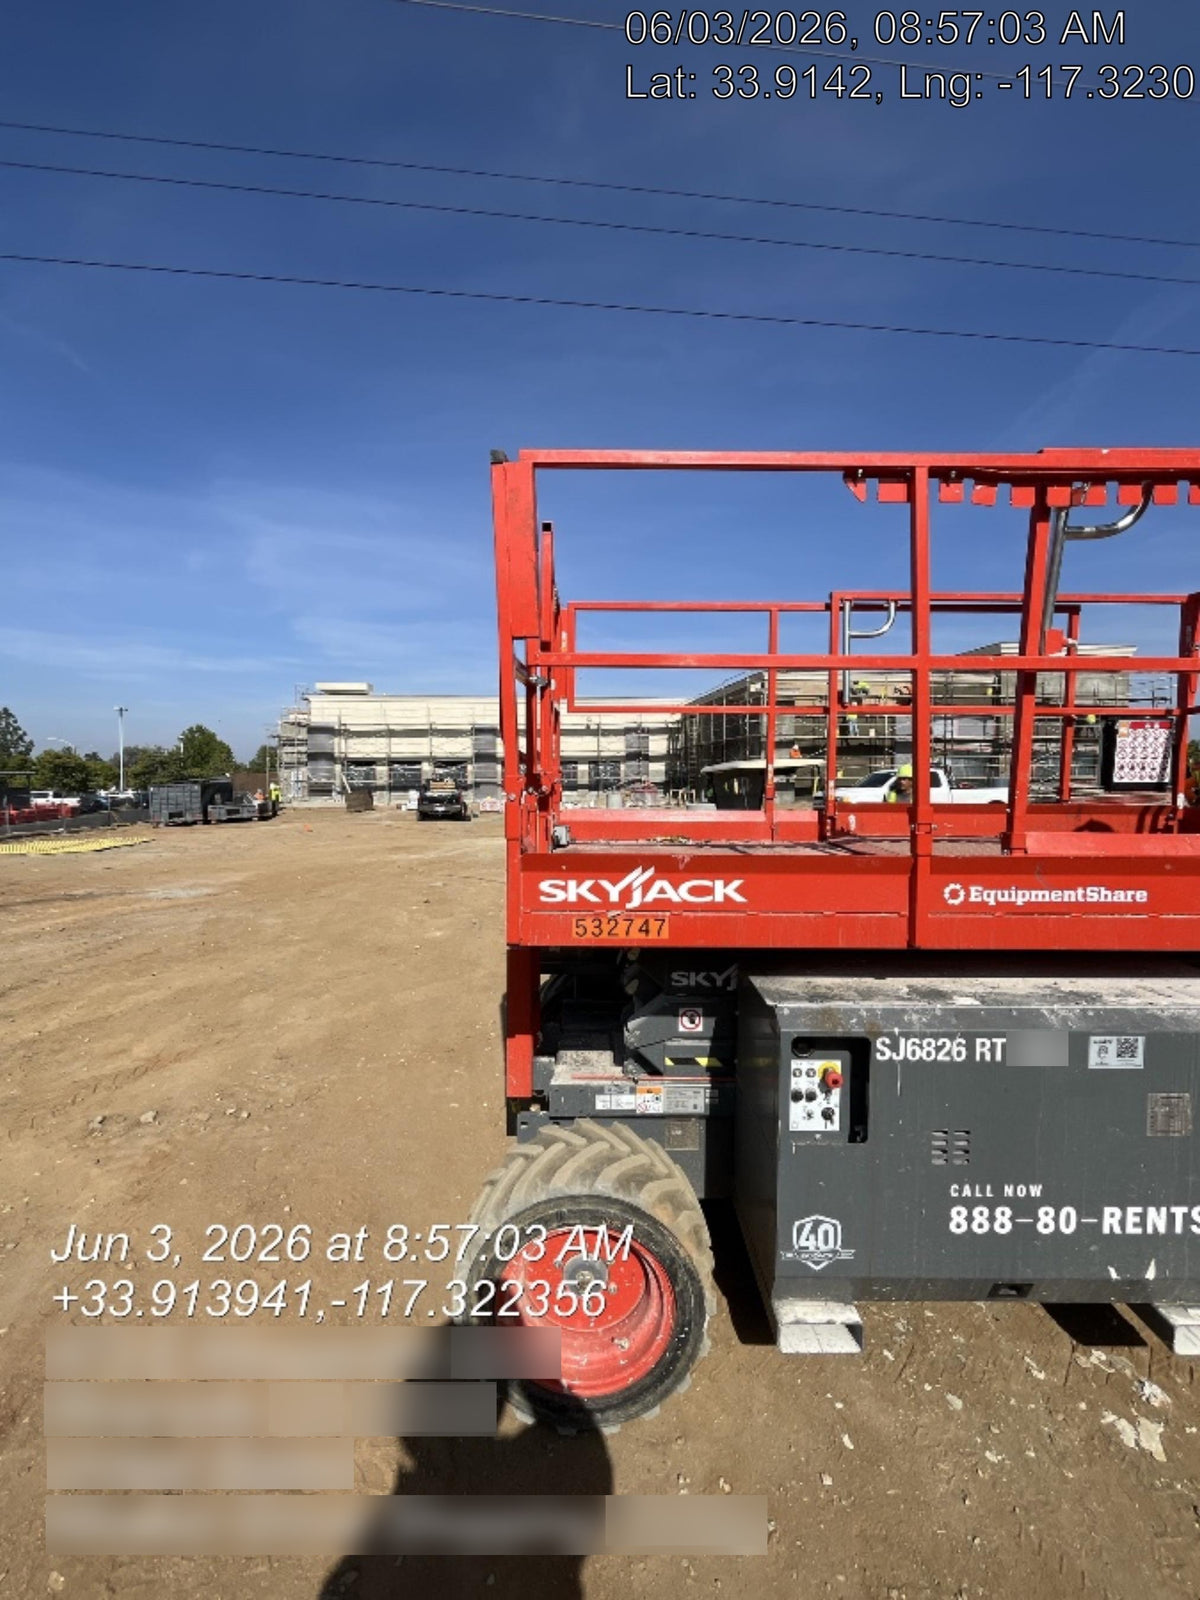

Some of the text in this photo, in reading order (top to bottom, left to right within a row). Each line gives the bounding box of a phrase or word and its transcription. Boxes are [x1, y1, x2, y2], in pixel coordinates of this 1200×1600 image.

[538, 866, 748, 909] SKYJACK
[969, 886, 1148, 906] EquipmentShare
[574, 918, 667, 938] 532747
[875, 1036, 967, 1062] SJ6826
[975, 1037, 1007, 1062] RT
[950, 1184, 1043, 1198] CALL NOW
[798, 1221, 835, 1251] 40
